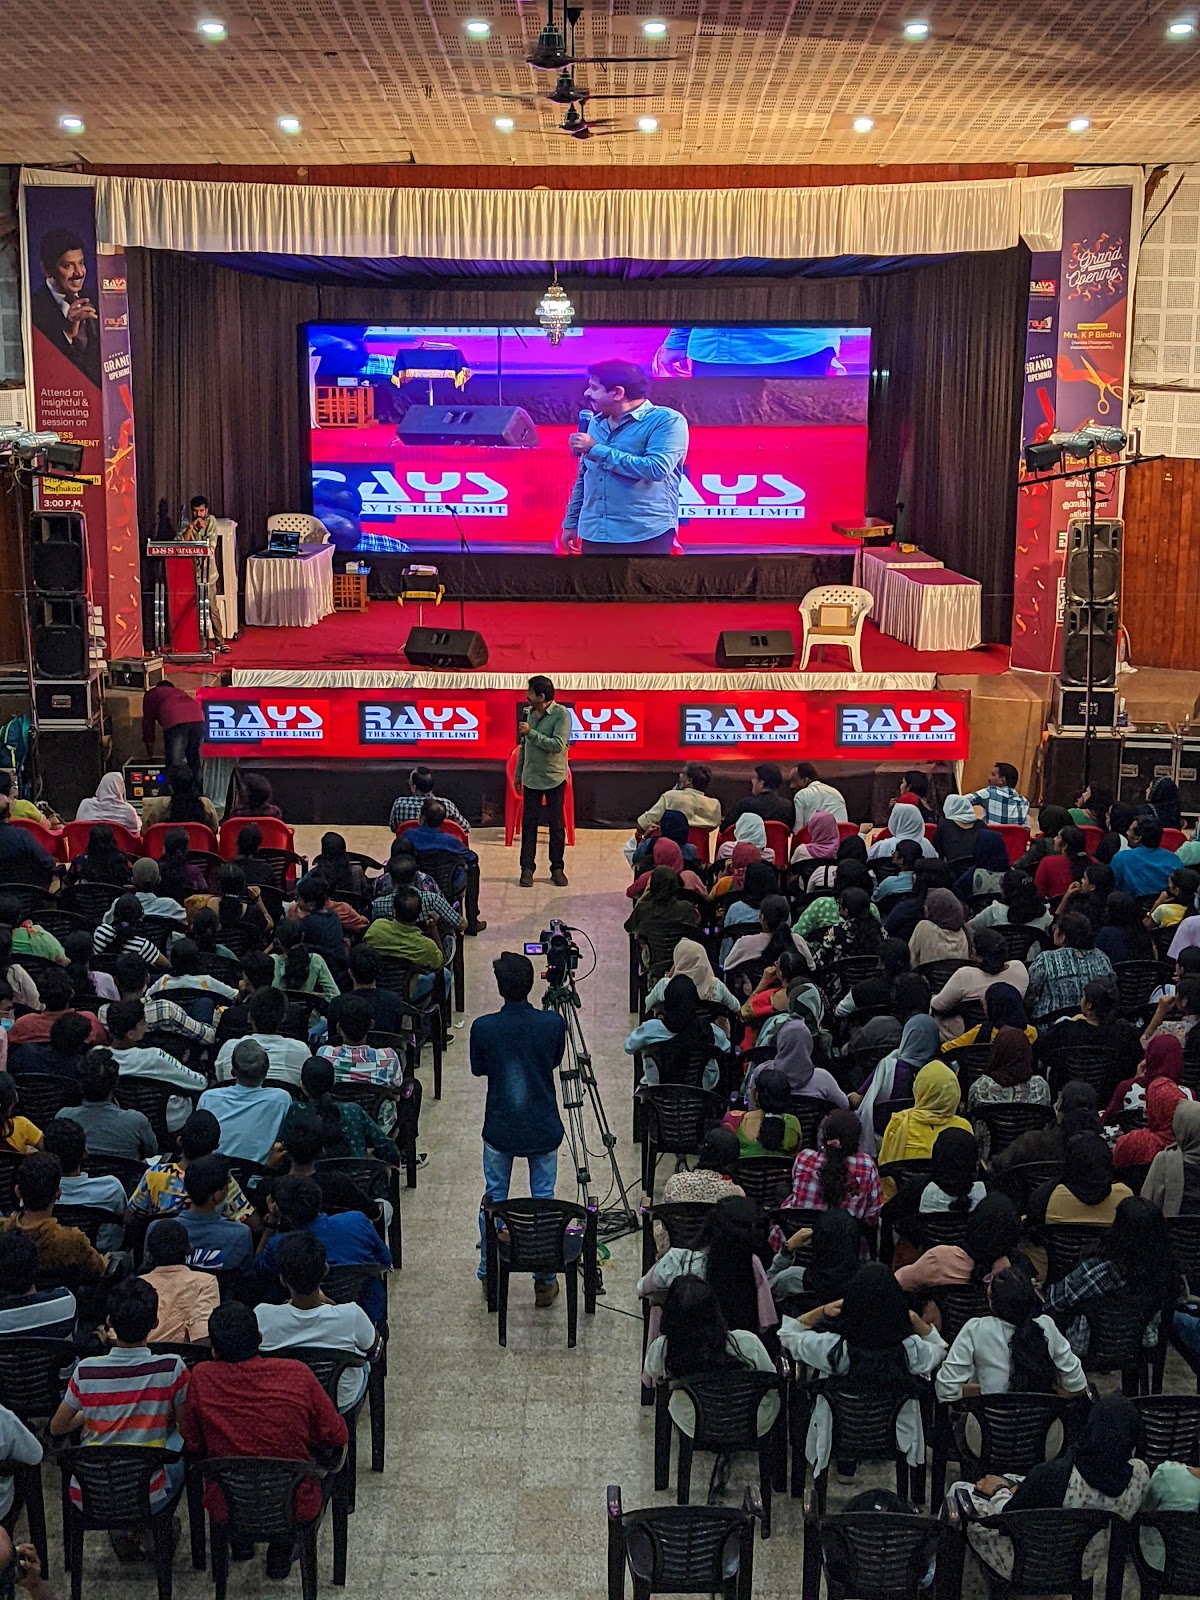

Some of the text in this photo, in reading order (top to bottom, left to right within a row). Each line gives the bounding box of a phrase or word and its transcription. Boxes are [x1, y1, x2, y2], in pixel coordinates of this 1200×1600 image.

[1078, 246, 1123, 272] Grand
[1066, 267, 1121, 288] Opening
[1063, 331, 1080, 339] Mrs.
[1025, 358, 1053, 374] GRAND
[41, 388, 71, 397] Attend
[41, 398, 89, 408] insightful &
[41, 409, 90, 418] motivating
[42, 418, 74, 426] session
[679, 474, 806, 505] AYS
[43, 499, 84, 508] 3:00 P.M.
[388, 504, 403, 513] IS
[410, 504, 445, 513] THE
[452, 505, 506, 514] LIMIT
[681, 507, 802, 517] IS THE LIMIT
[151, 547, 175, 555] DSS
[208, 705, 324, 728] RAYS
[365, 706, 479, 730] RAYS
[566, 708, 637, 731] AYS
[686, 709, 800, 732] RAYS
[842, 709, 957, 732] RAYS
[292, 730, 322, 738] LIMIT
[425, 731, 445, 739] THE
[448, 731, 478, 739] LIMIT
[606, 732, 635, 740] LIMIT
